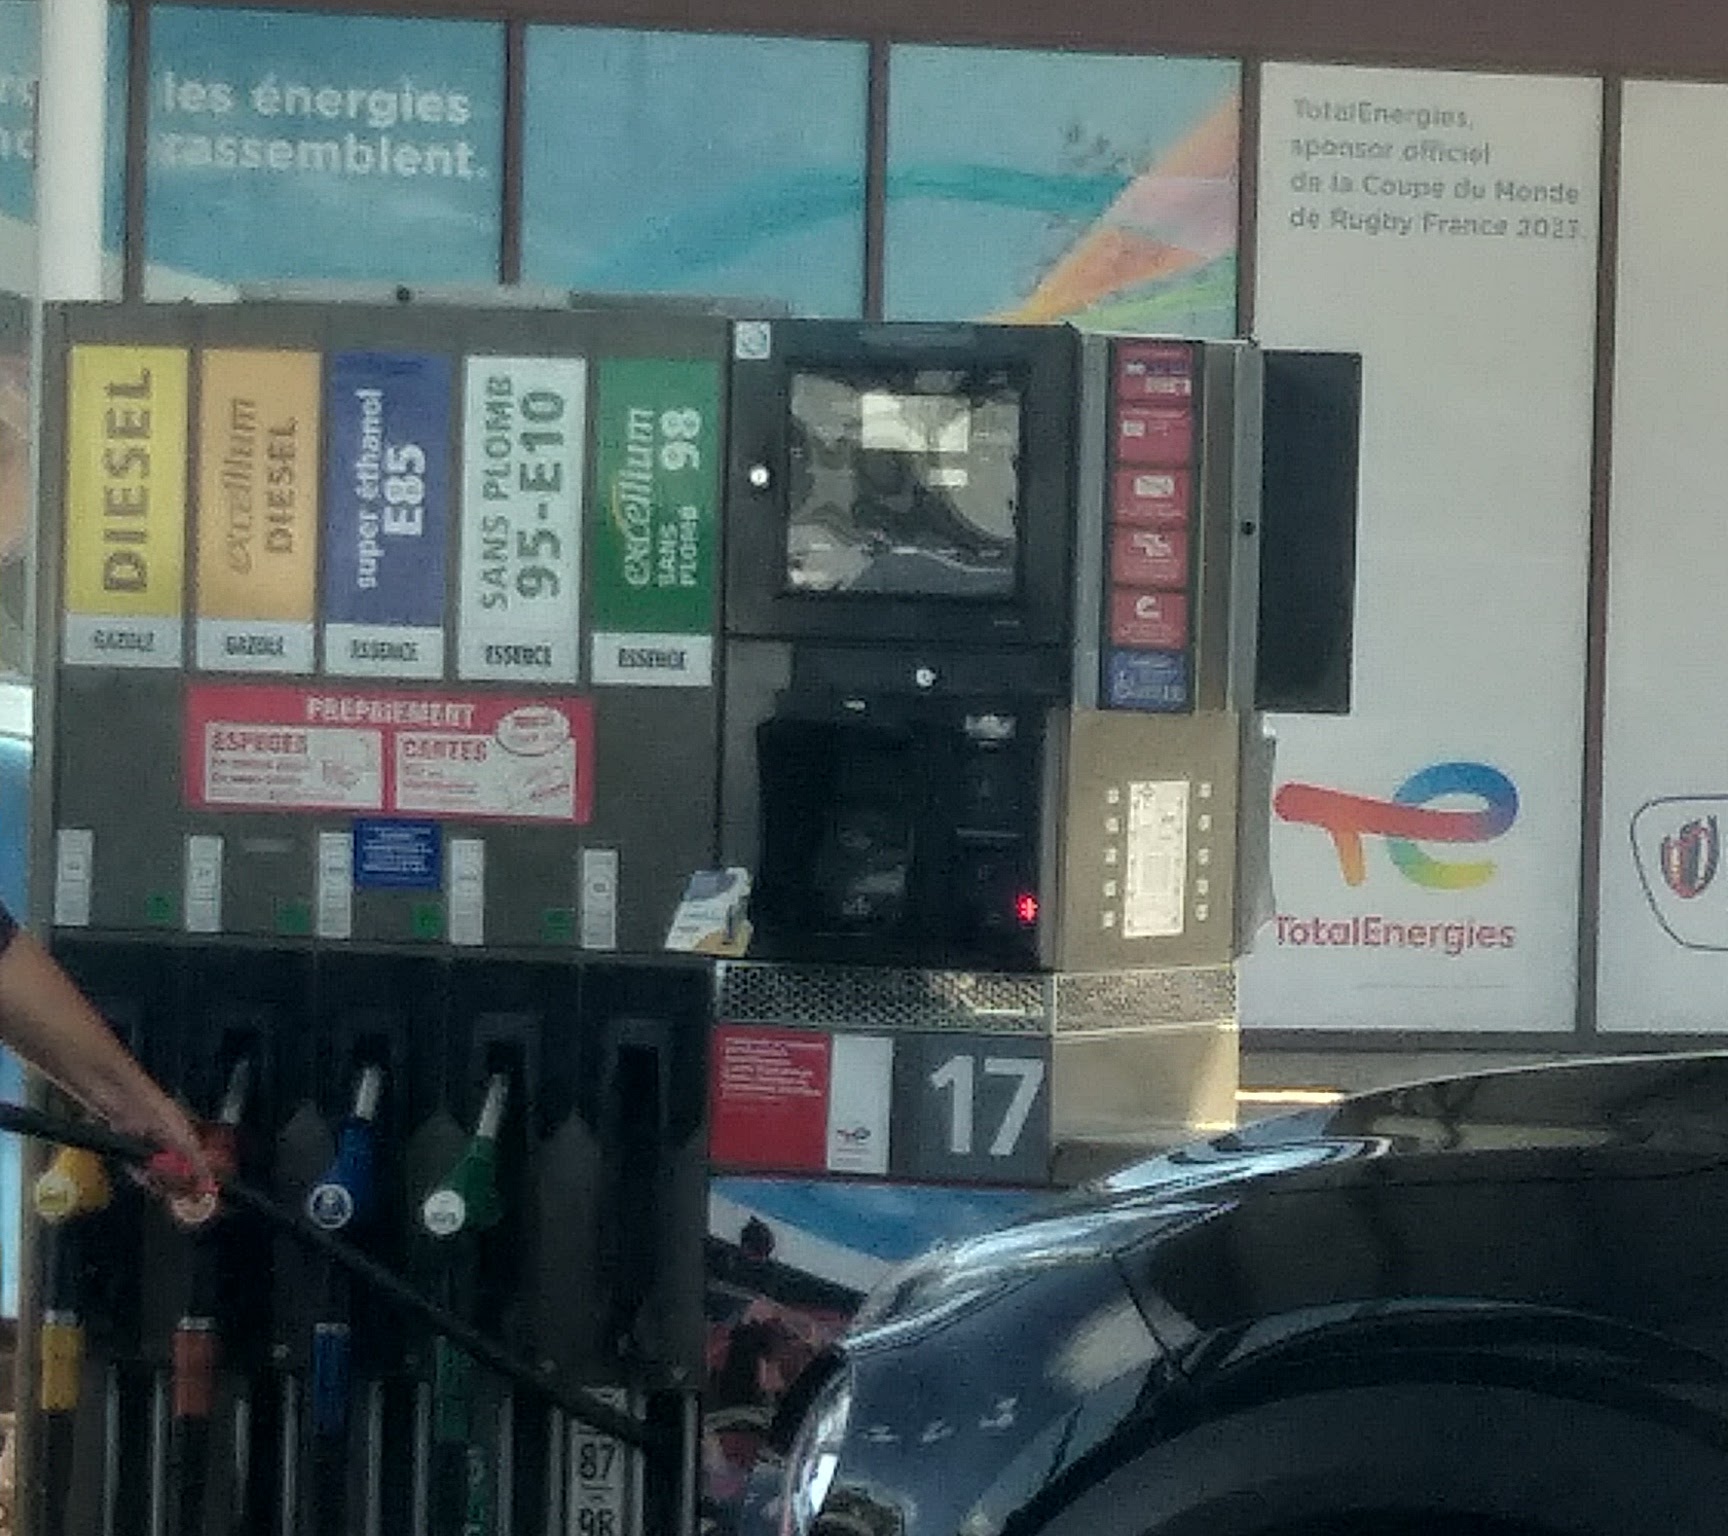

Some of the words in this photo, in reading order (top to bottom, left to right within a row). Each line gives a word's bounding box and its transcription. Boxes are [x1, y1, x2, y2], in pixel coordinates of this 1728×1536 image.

[163, 70, 236, 114] les
[250, 72, 472, 128] énergies
[155, 131, 487, 178] rassemblent.
[1290, 138, 1394, 161] sponsor
[1290, 171, 1321, 194] de
[1330, 172, 1354, 194] la
[1361, 174, 1446, 200] Coupe
[1453, 177, 1486, 200] du
[1494, 180, 1580, 205] Monde
[1290, 207, 1321, 230] de
[1330, 207, 1413, 237] Rugby
[1422, 211, 1508, 238] France
[484, 375, 514, 502] PLOMB
[659, 408, 702, 471] 98
[103, 367, 152, 594] DIESEL
[265, 417, 298, 554] DIESEL
[384, 444, 426, 536] E85
[515, 391, 566, 601] 95-E10
[356, 508, 385, 589] super
[481, 512, 510, 611] SANS
[1278, 916, 1516, 956] TotalEnergies
[931, 1055, 1044, 1156] 17
